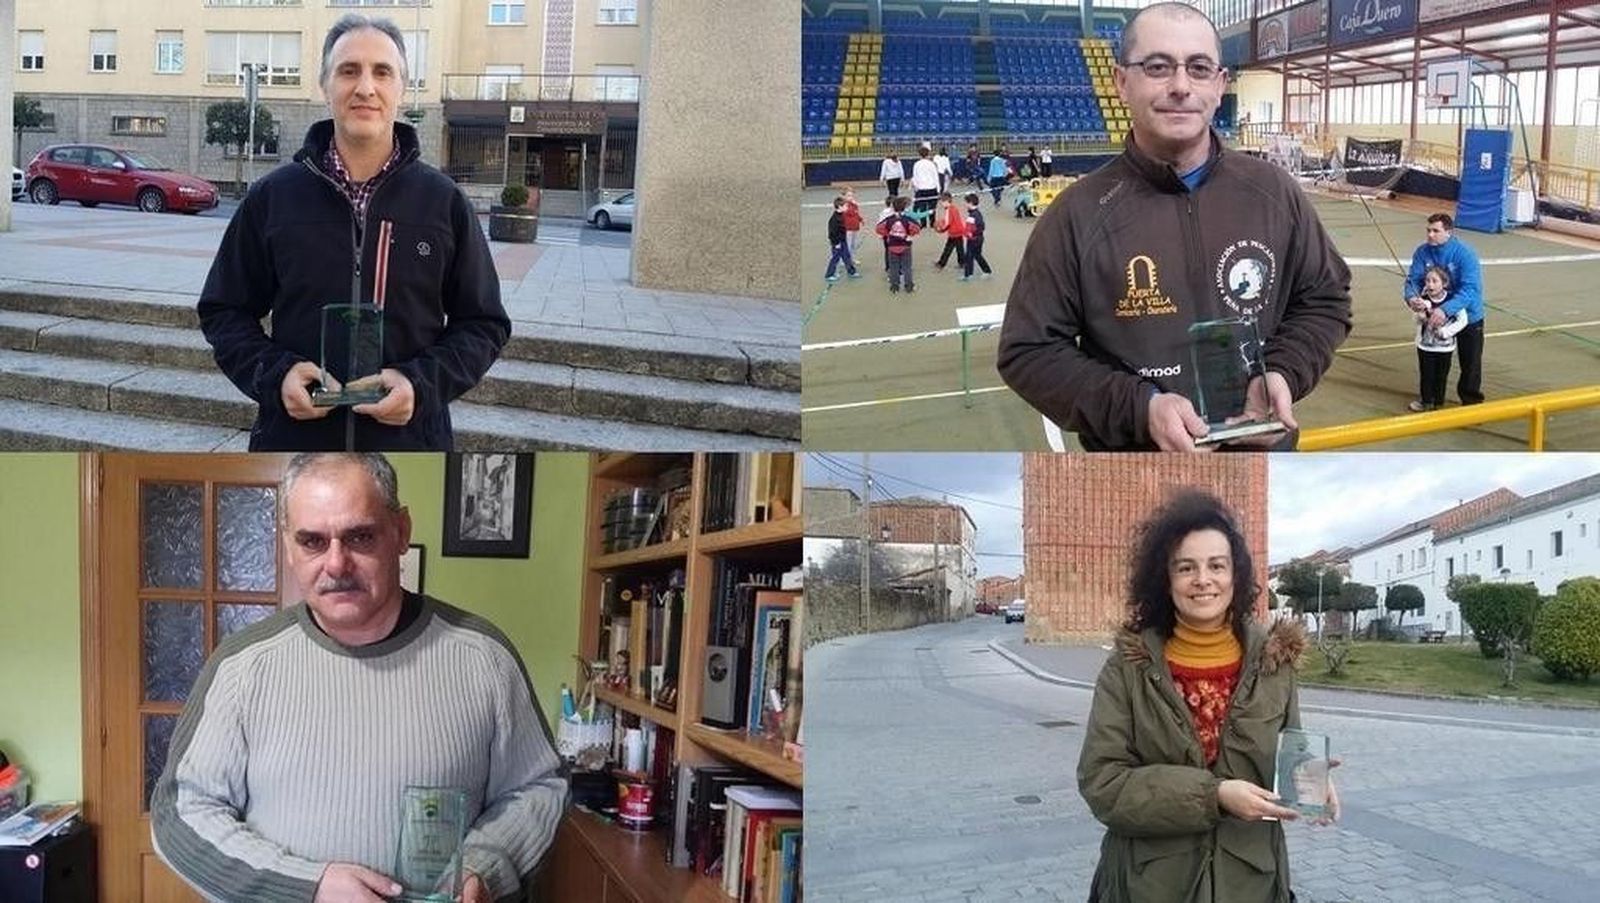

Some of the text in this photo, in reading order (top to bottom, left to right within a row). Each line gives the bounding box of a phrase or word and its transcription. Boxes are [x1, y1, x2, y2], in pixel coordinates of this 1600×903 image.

[1339, 10, 1361, 32] Caja
[1355, 0, 1402, 26] Duero
[1145, 296, 1172, 307] VILLA
